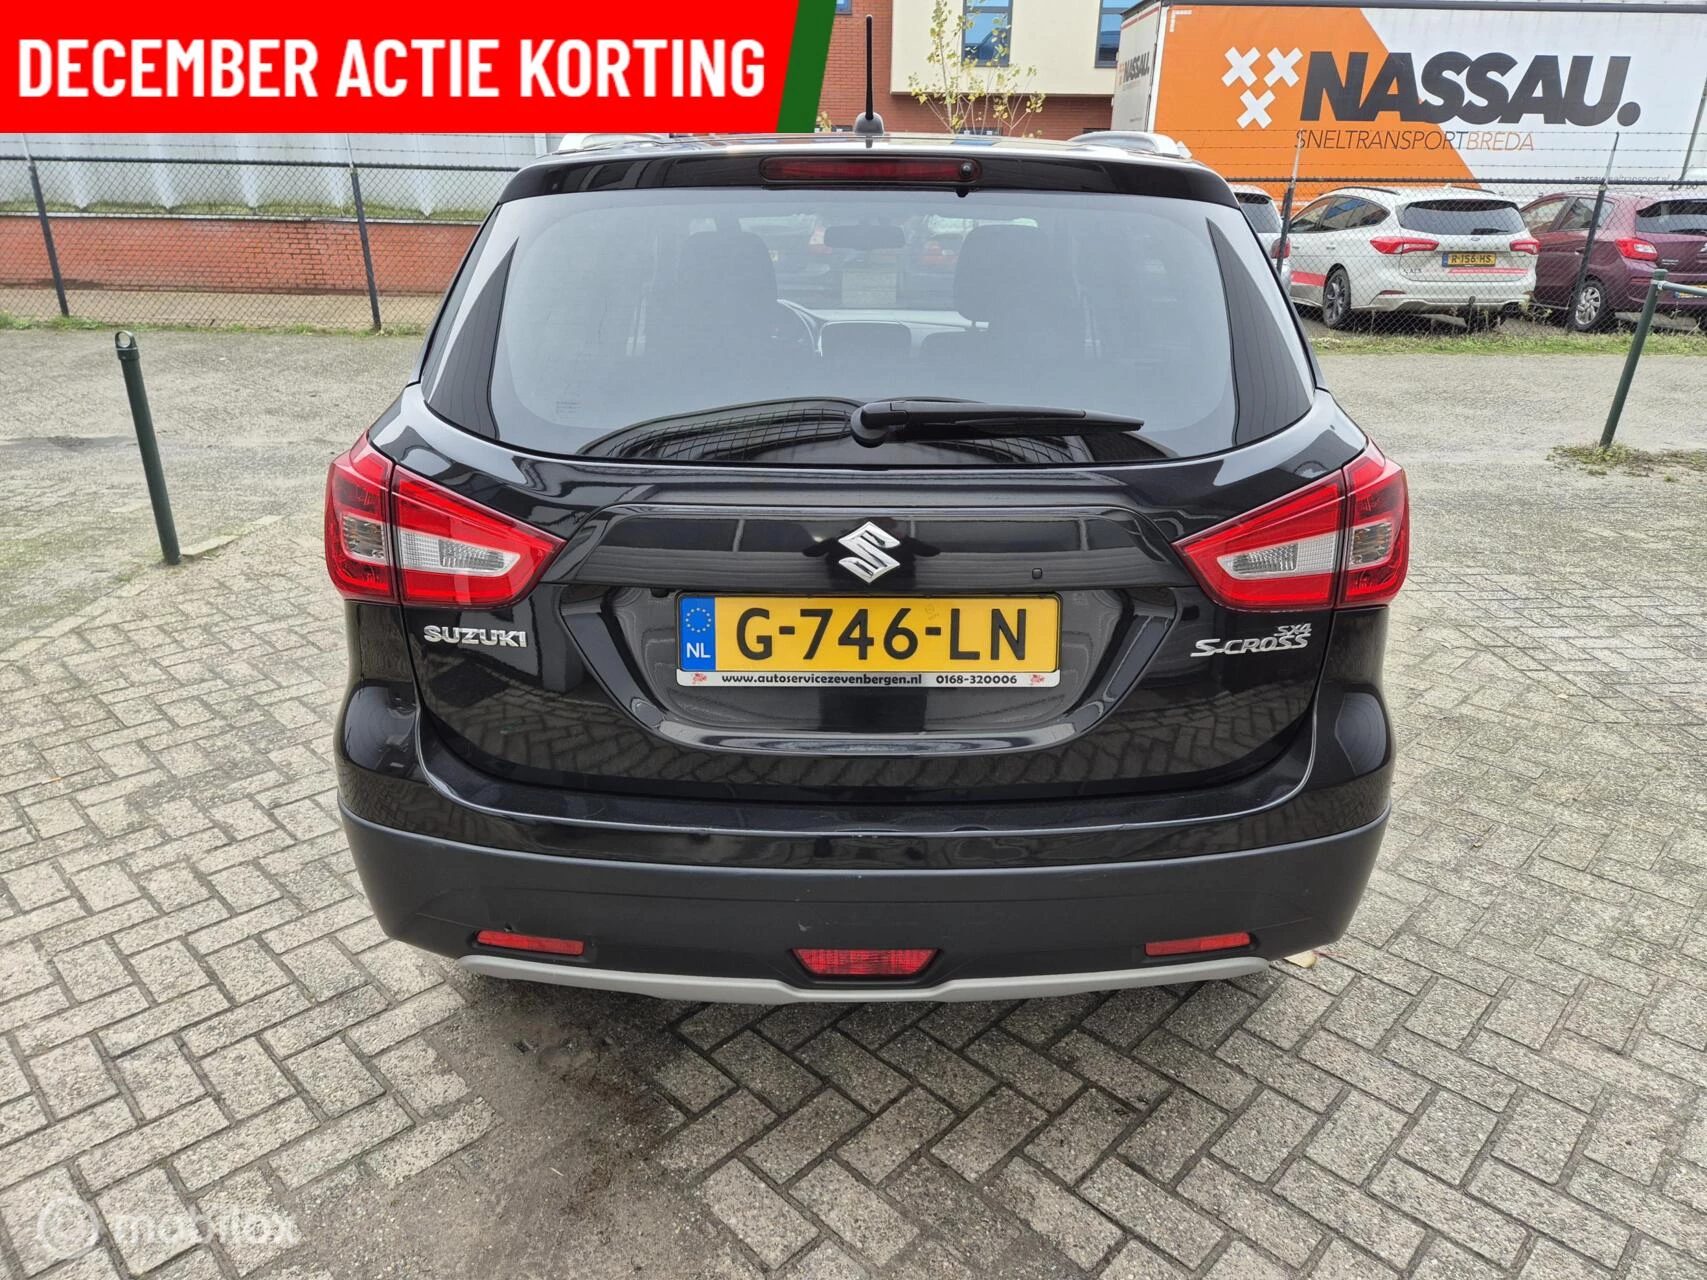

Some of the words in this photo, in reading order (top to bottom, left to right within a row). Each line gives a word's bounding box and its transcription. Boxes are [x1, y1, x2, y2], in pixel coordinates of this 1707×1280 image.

[424, 625, 528, 648] SUZUKI
[736, 608, 1027, 661] G-746-LN
[1273, 622, 1313, 636] SX4
[686, 642, 711, 659] NL
[1190, 632, 1312, 657] S-CROSS
[722, 673, 922, 687] www.autoservicezevenbergen.nl
[936, 674, 1018, 685] 0168-320006
